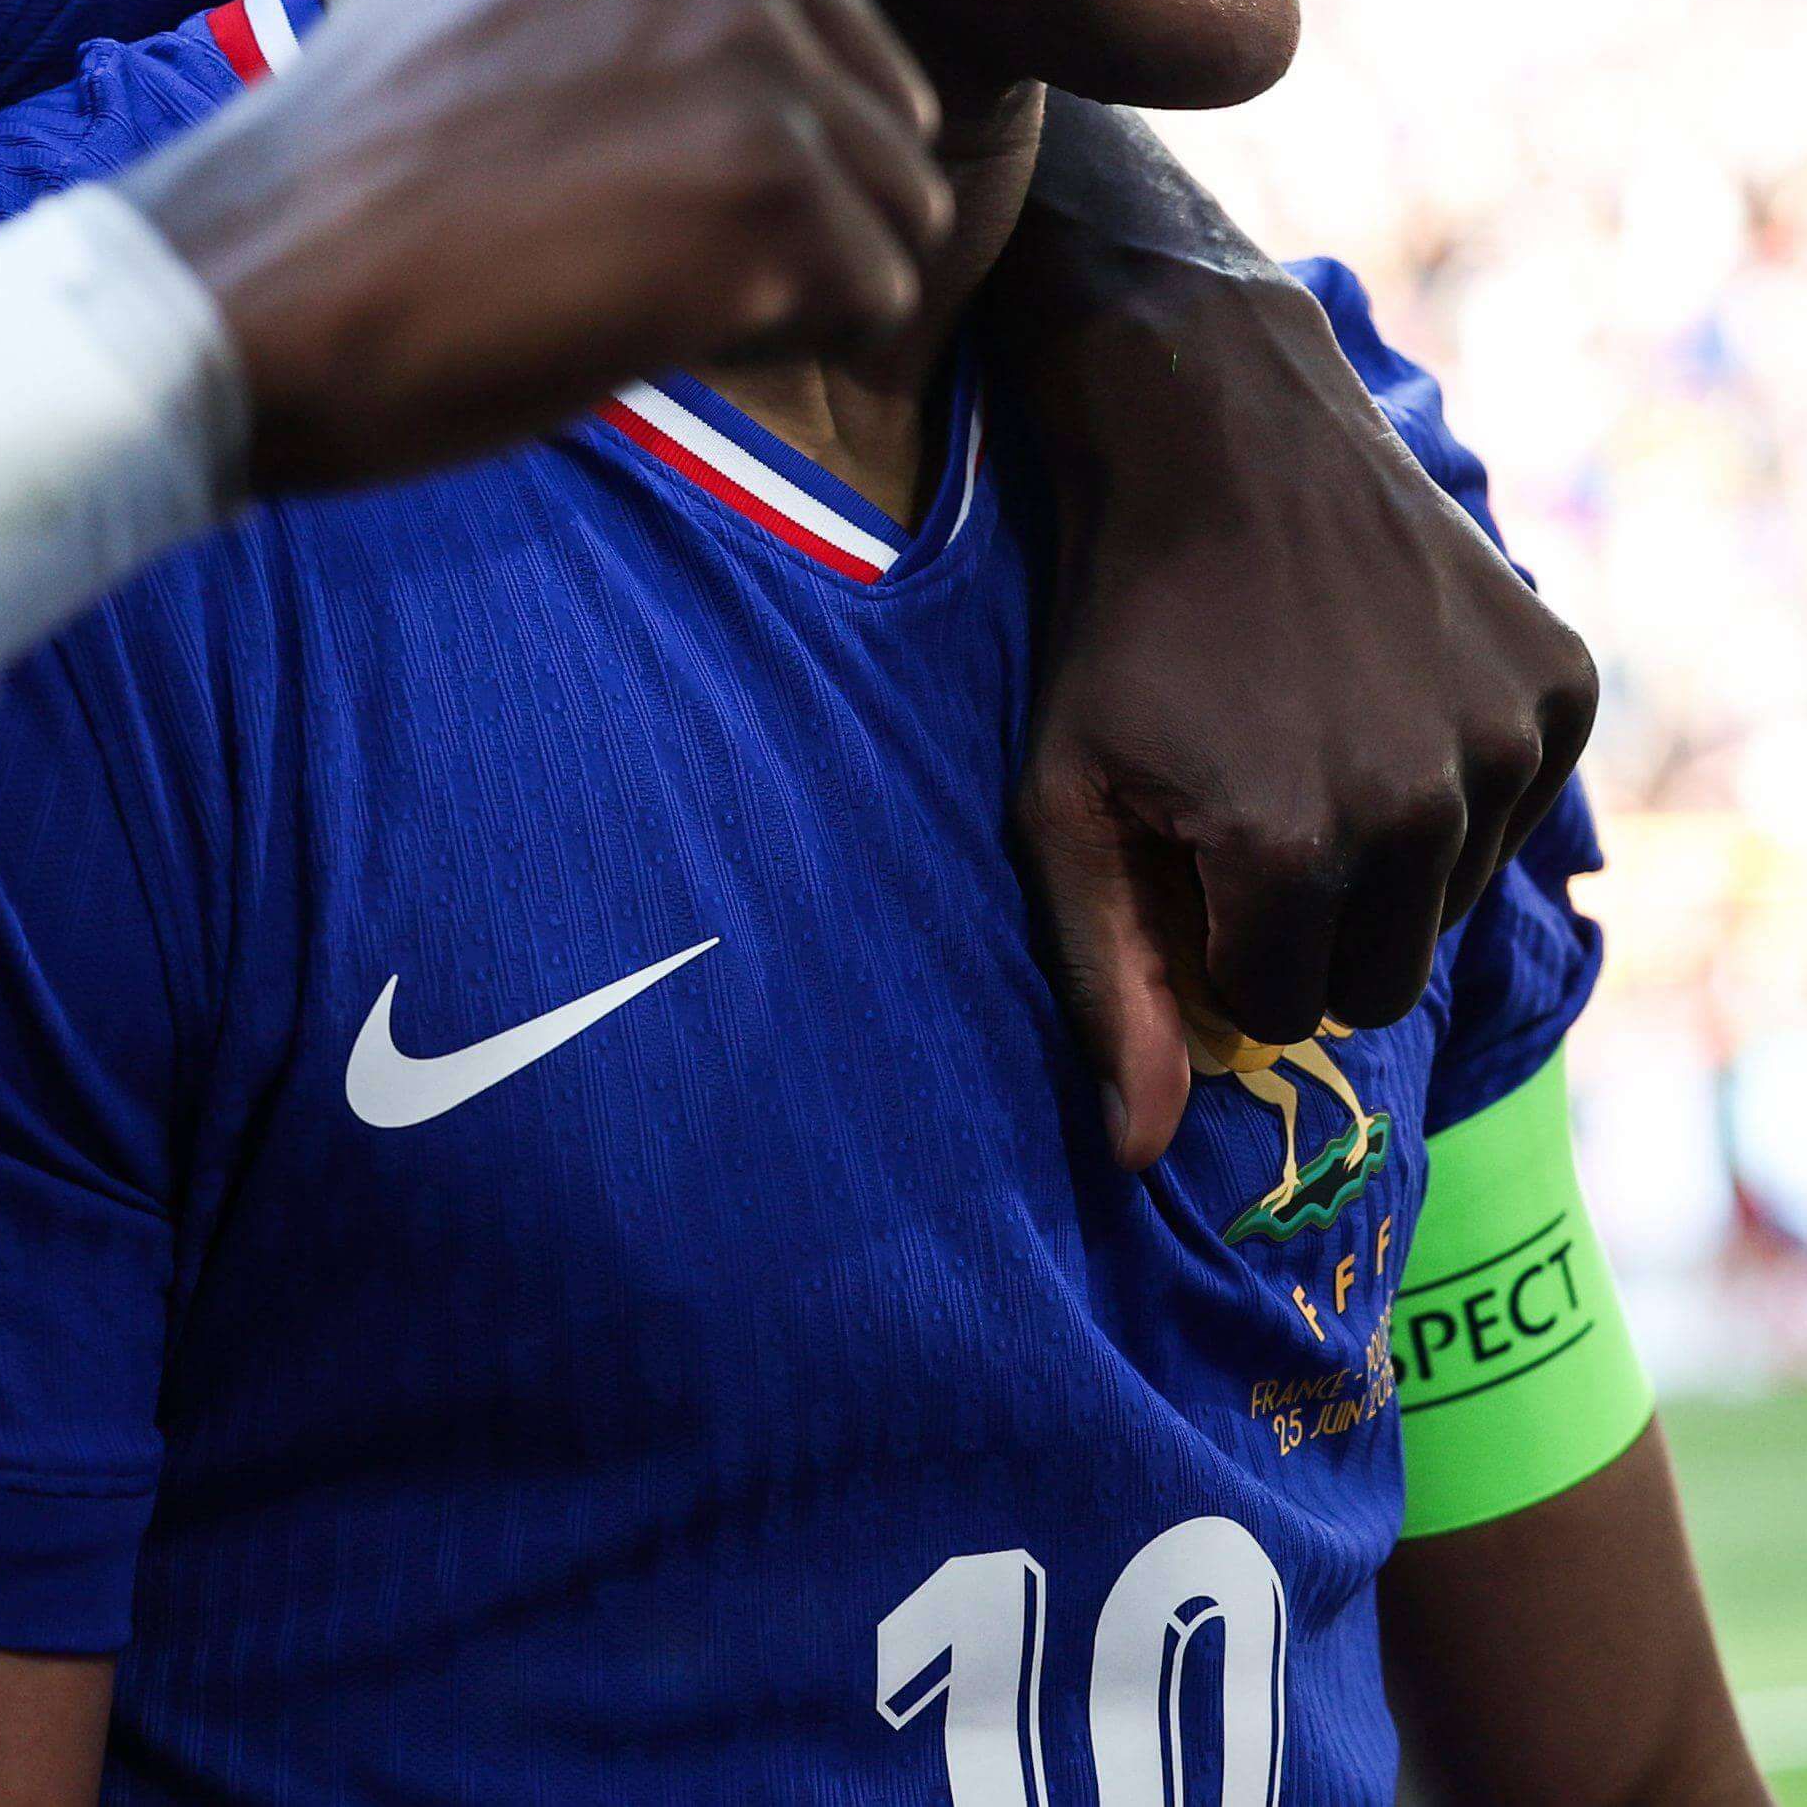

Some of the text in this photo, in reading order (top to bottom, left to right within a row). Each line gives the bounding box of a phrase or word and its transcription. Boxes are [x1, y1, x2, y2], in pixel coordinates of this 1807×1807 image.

[1251, 1368, 1351, 1420] FRANCE
[1273, 1407, 1304, 1457] 25
[1310, 1393, 1367, 1440] JUIN
